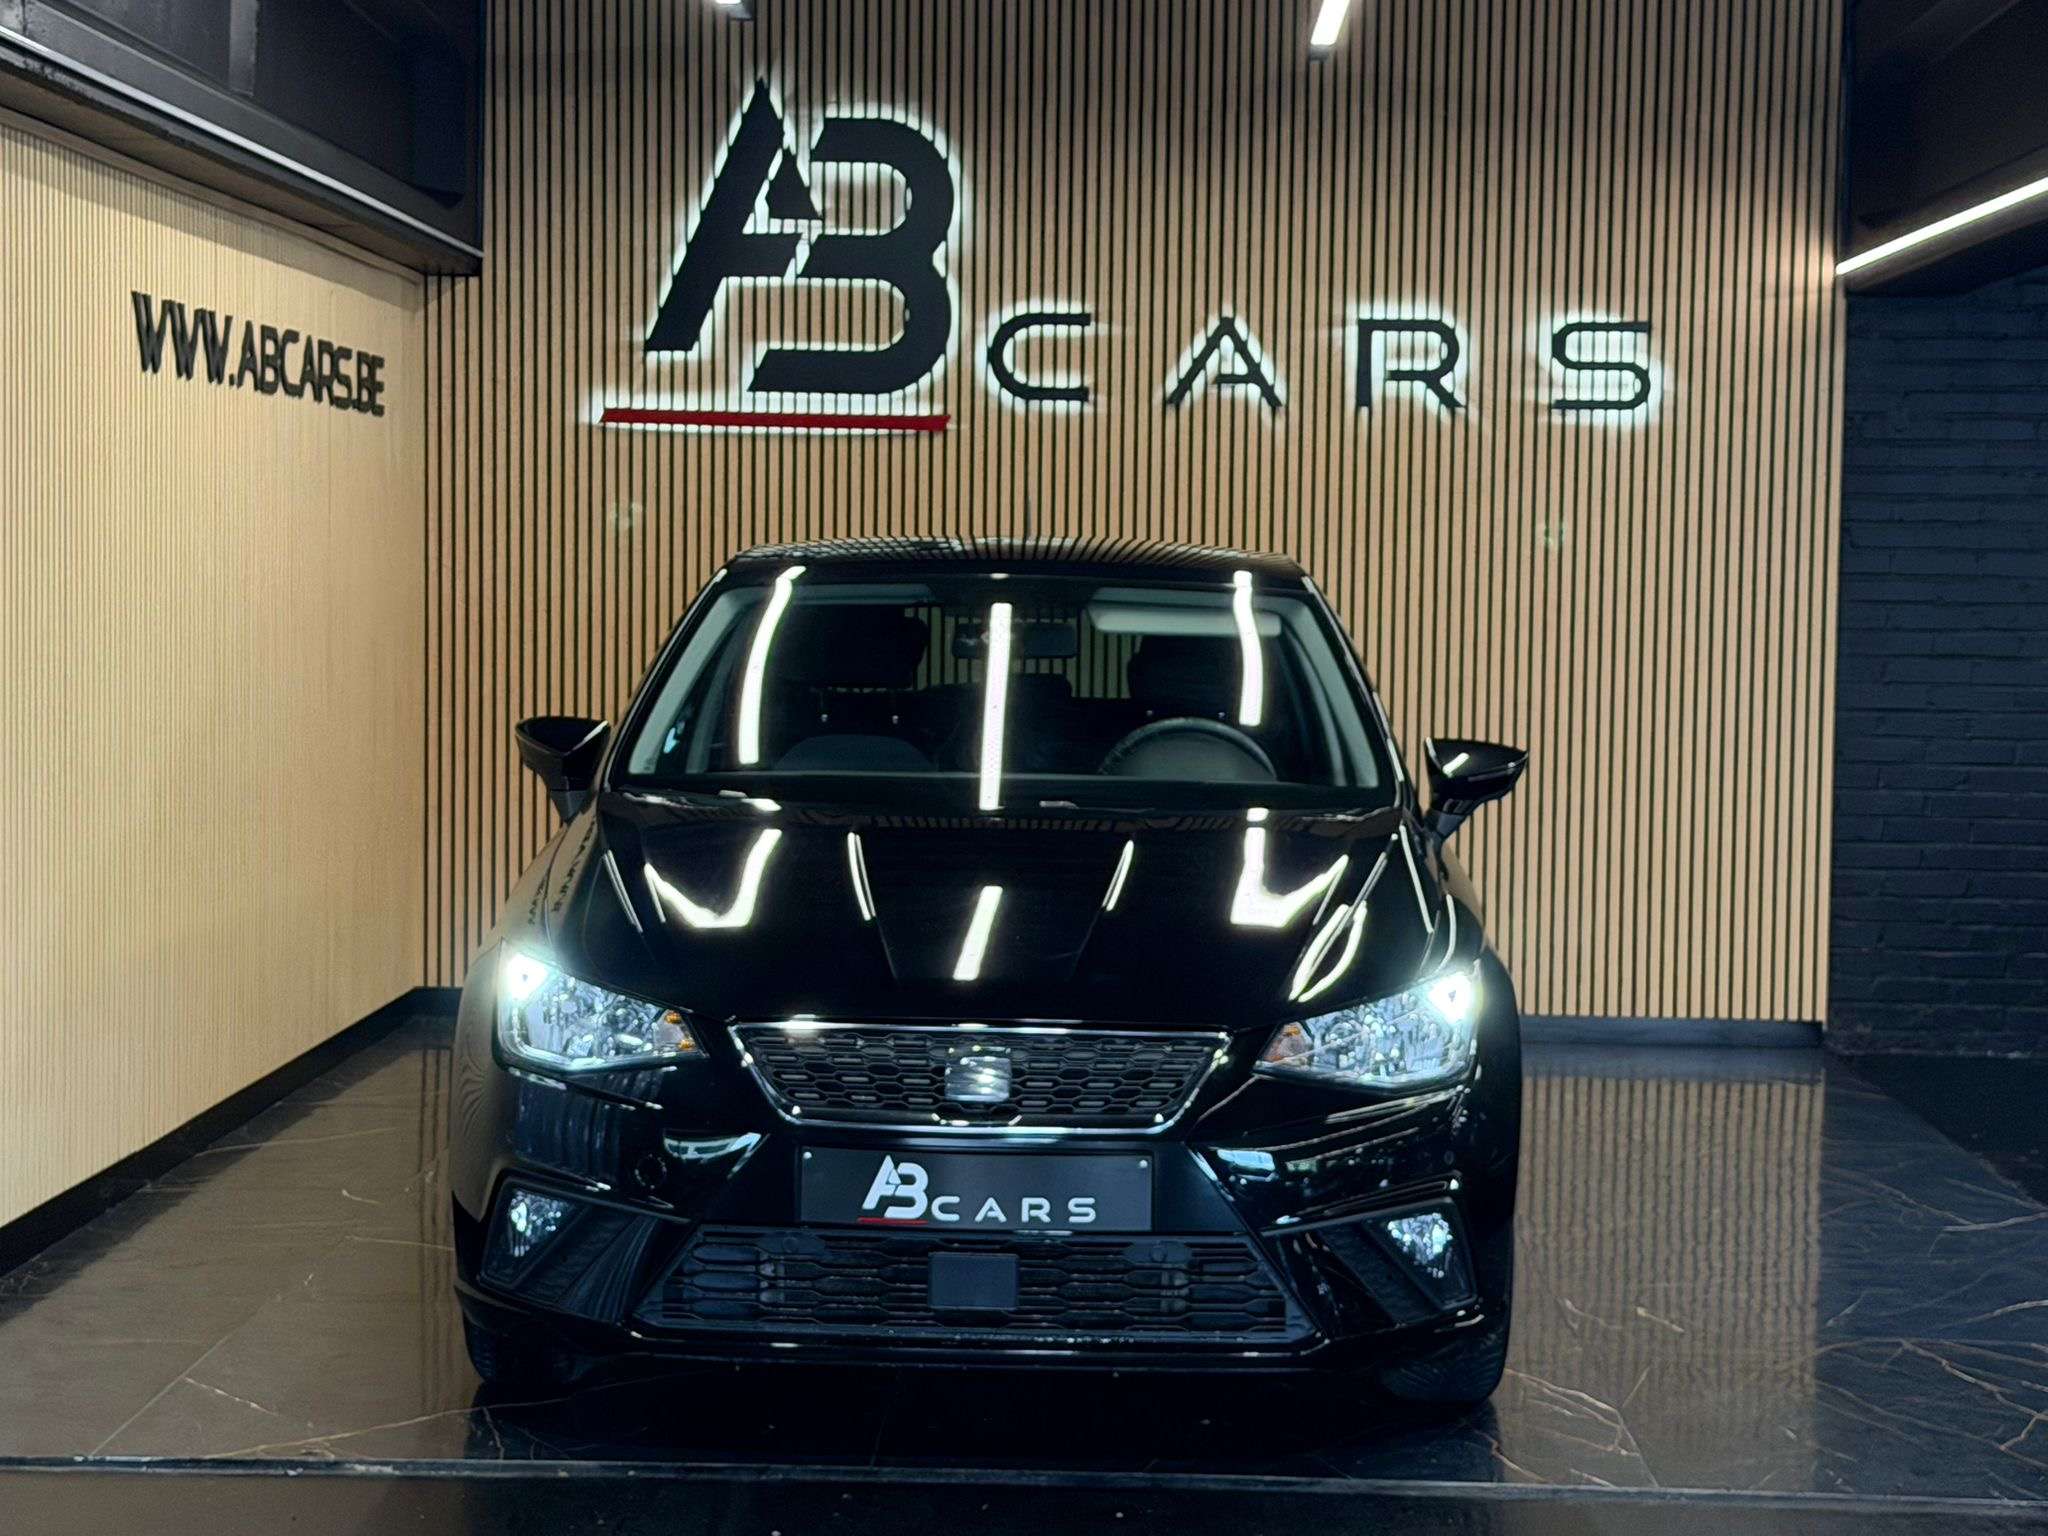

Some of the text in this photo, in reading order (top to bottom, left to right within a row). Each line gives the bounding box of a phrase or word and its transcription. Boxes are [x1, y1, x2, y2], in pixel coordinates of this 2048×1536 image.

[643, 76, 1652, 410] AB CARS
[131, 290, 385, 417] WWW.ABCARS.BE
[862, 1155, 1096, 1224] AB CARS
